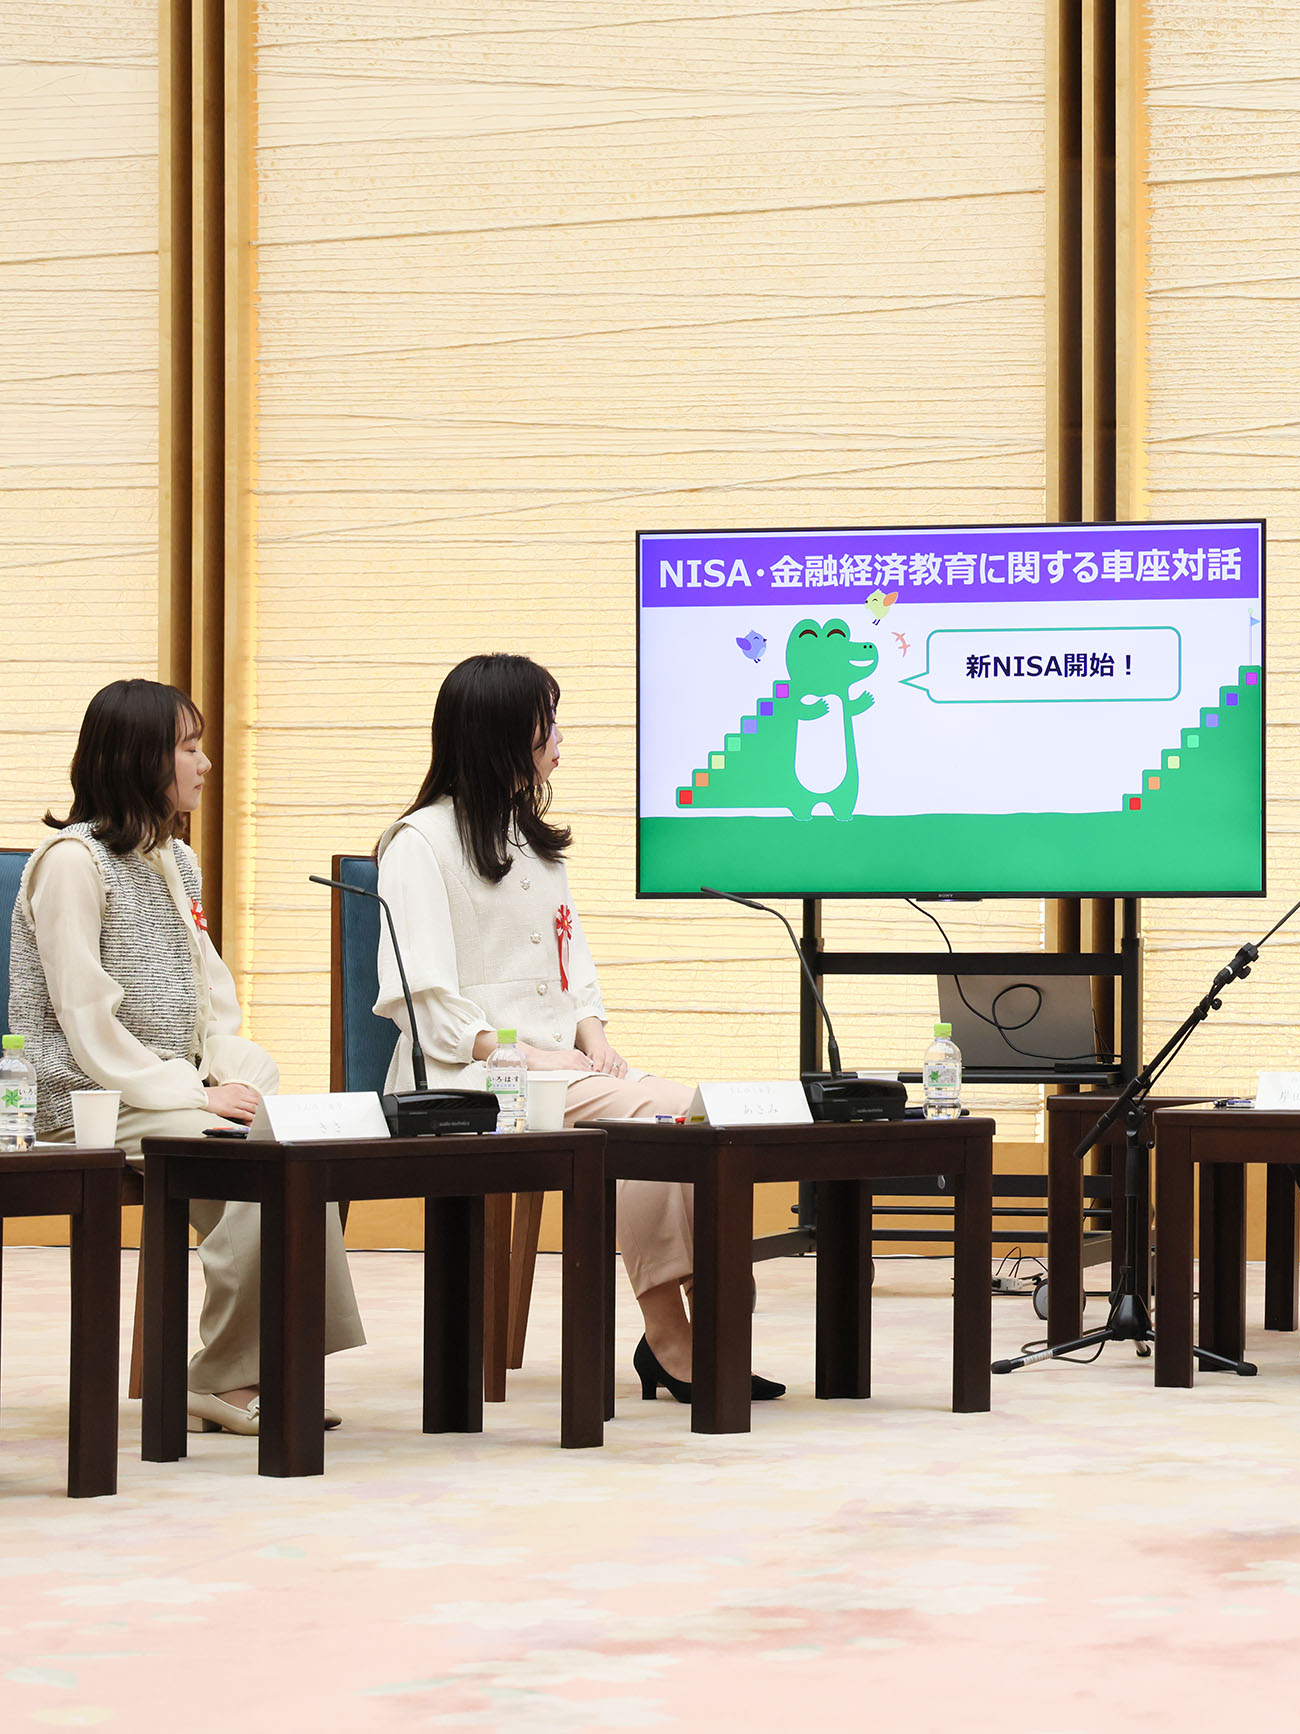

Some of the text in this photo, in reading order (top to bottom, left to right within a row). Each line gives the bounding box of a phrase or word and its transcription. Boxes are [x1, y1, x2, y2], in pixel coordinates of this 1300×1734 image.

[659, 547, 1242, 588] NISA・金融経済教育に関する車座対話
[966, 652, 1132, 679] 新NISA開始！
